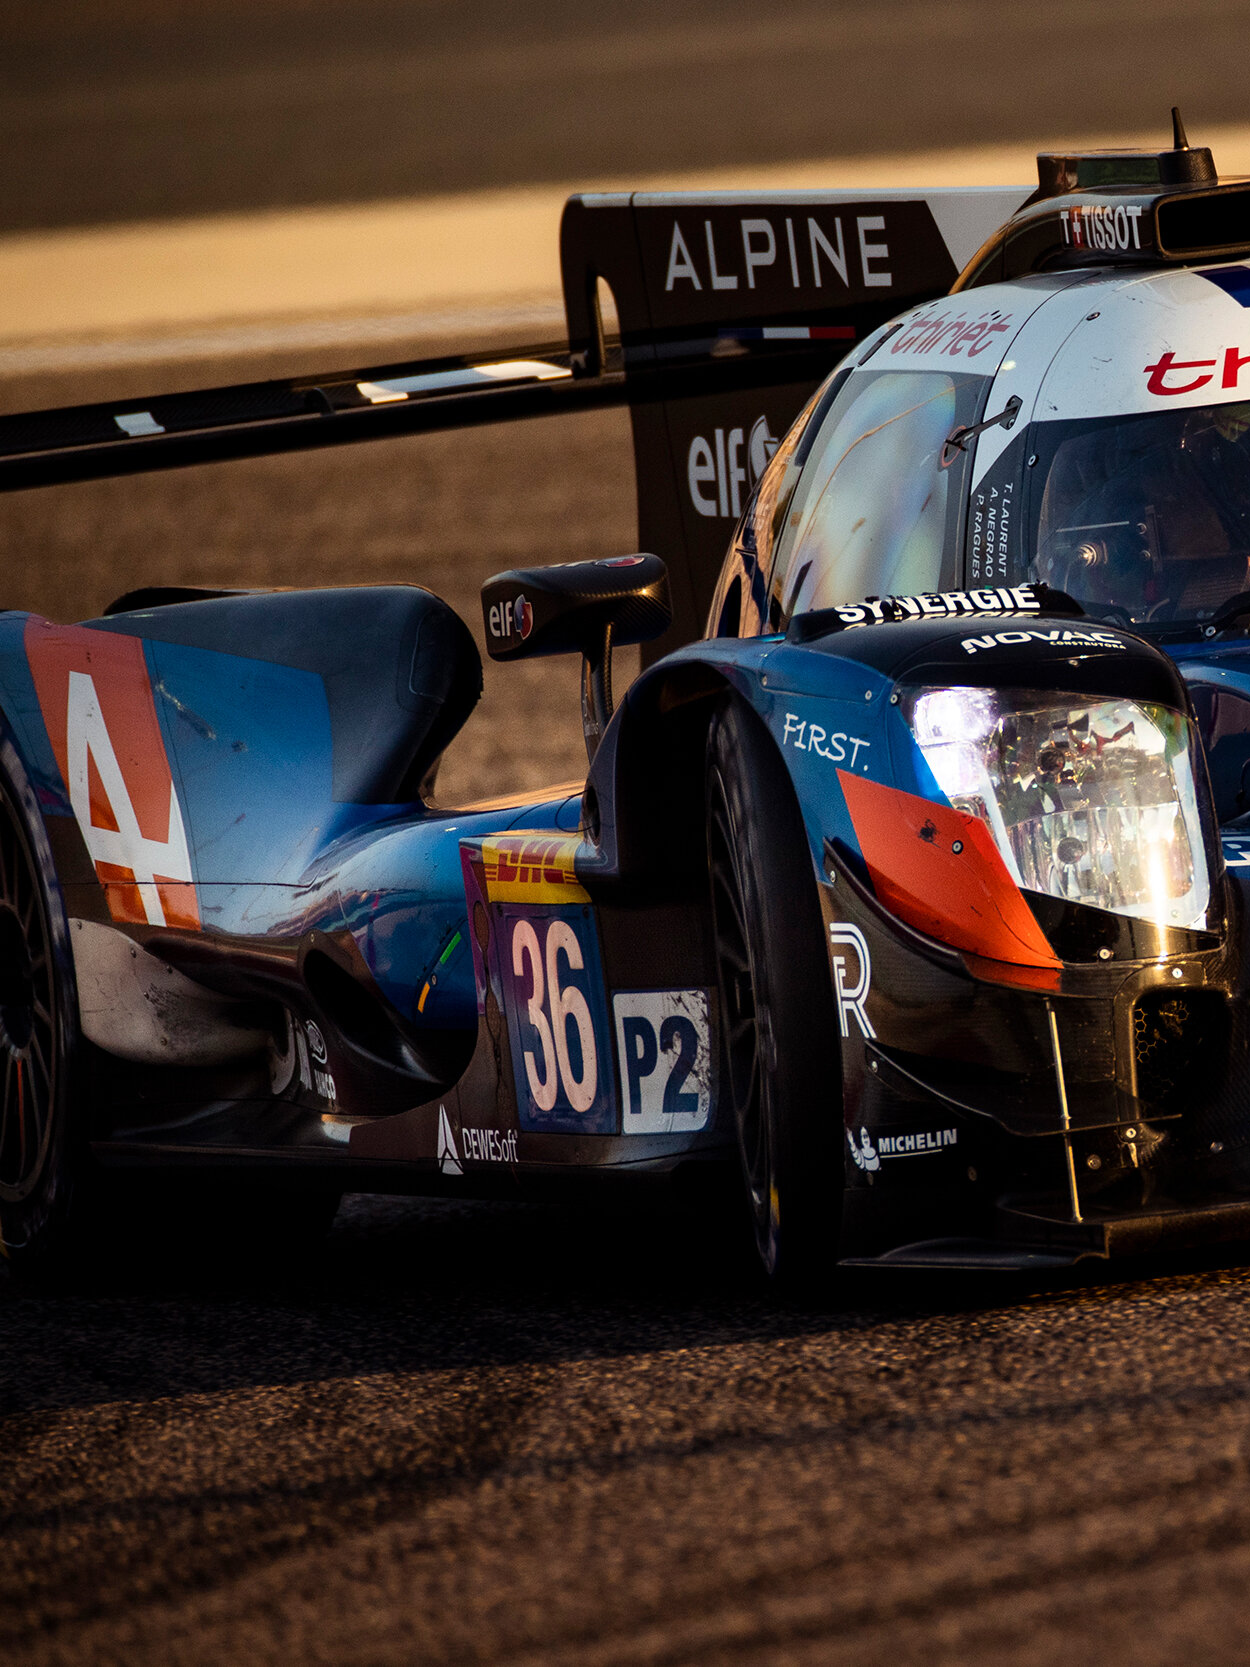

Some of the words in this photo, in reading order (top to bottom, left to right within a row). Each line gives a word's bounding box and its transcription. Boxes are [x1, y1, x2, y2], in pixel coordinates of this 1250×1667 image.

[665, 215, 894, 291] ALPINE
[688, 428, 746, 519] elf
[1004, 482, 1014, 493] T.
[976, 494, 985, 506] P.
[989, 487, 999, 502] A.
[972, 511, 983, 578] RAGUES
[985, 507, 997, 578] NEGRAO
[998, 498, 1011, 577] LAURENT
[489, 600, 513, 637] elf
[834, 587, 1040, 623] SYNERGIE
[961, 630, 1122, 654] NOVAC
[496, 838, 567, 884] DHL
[512, 919, 598, 1112] 36
[622, 1015, 700, 1115] P2
[462, 1127, 519, 1163] DEWESoft
[878, 1128, 957, 1153] MICHELIN
